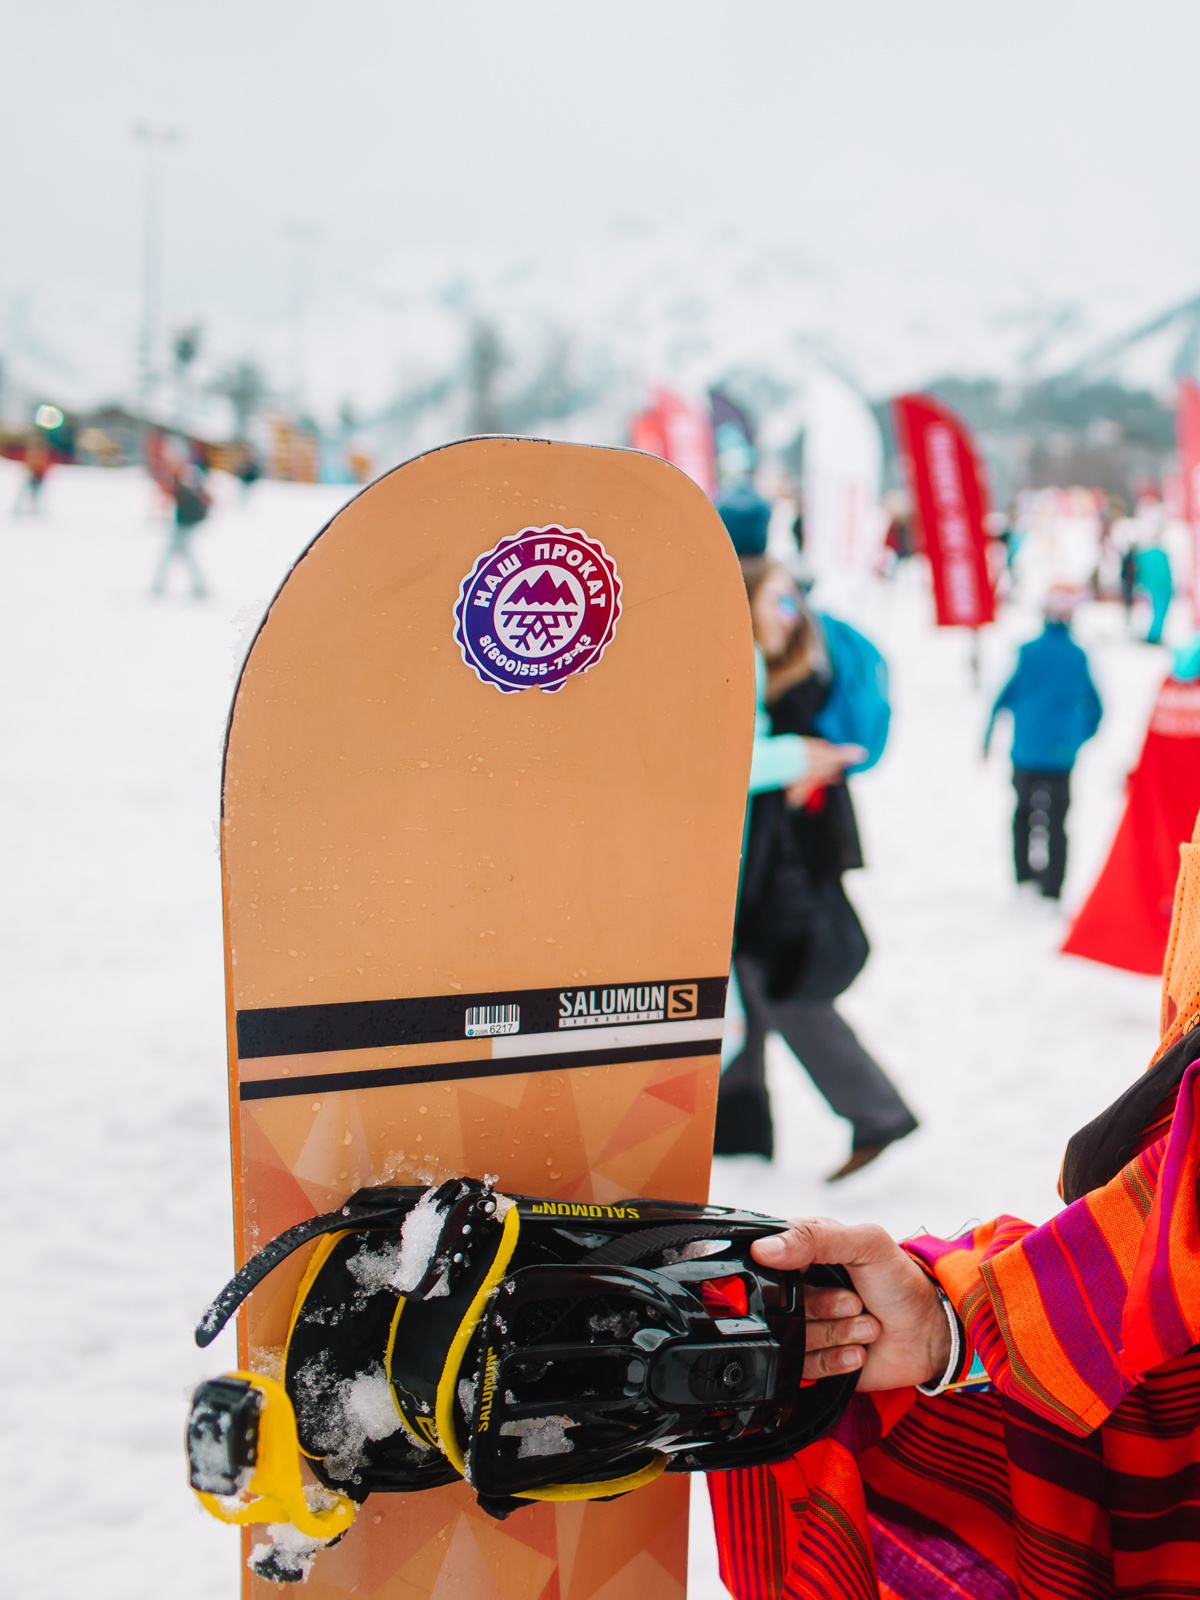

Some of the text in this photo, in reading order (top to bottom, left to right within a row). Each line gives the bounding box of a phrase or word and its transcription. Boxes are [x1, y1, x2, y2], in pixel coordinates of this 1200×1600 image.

[473, 543, 606, 608] НАШ ПРОКАТ
[558, 985, 665, 1017] SALOMON
[489, 1023, 513, 1034] 6217
[562, 1010, 661, 1026] SNOWBOARDS
[542, 1202, 640, 1219] SALOMON
[478, 1356, 498, 1433] SALOMON
